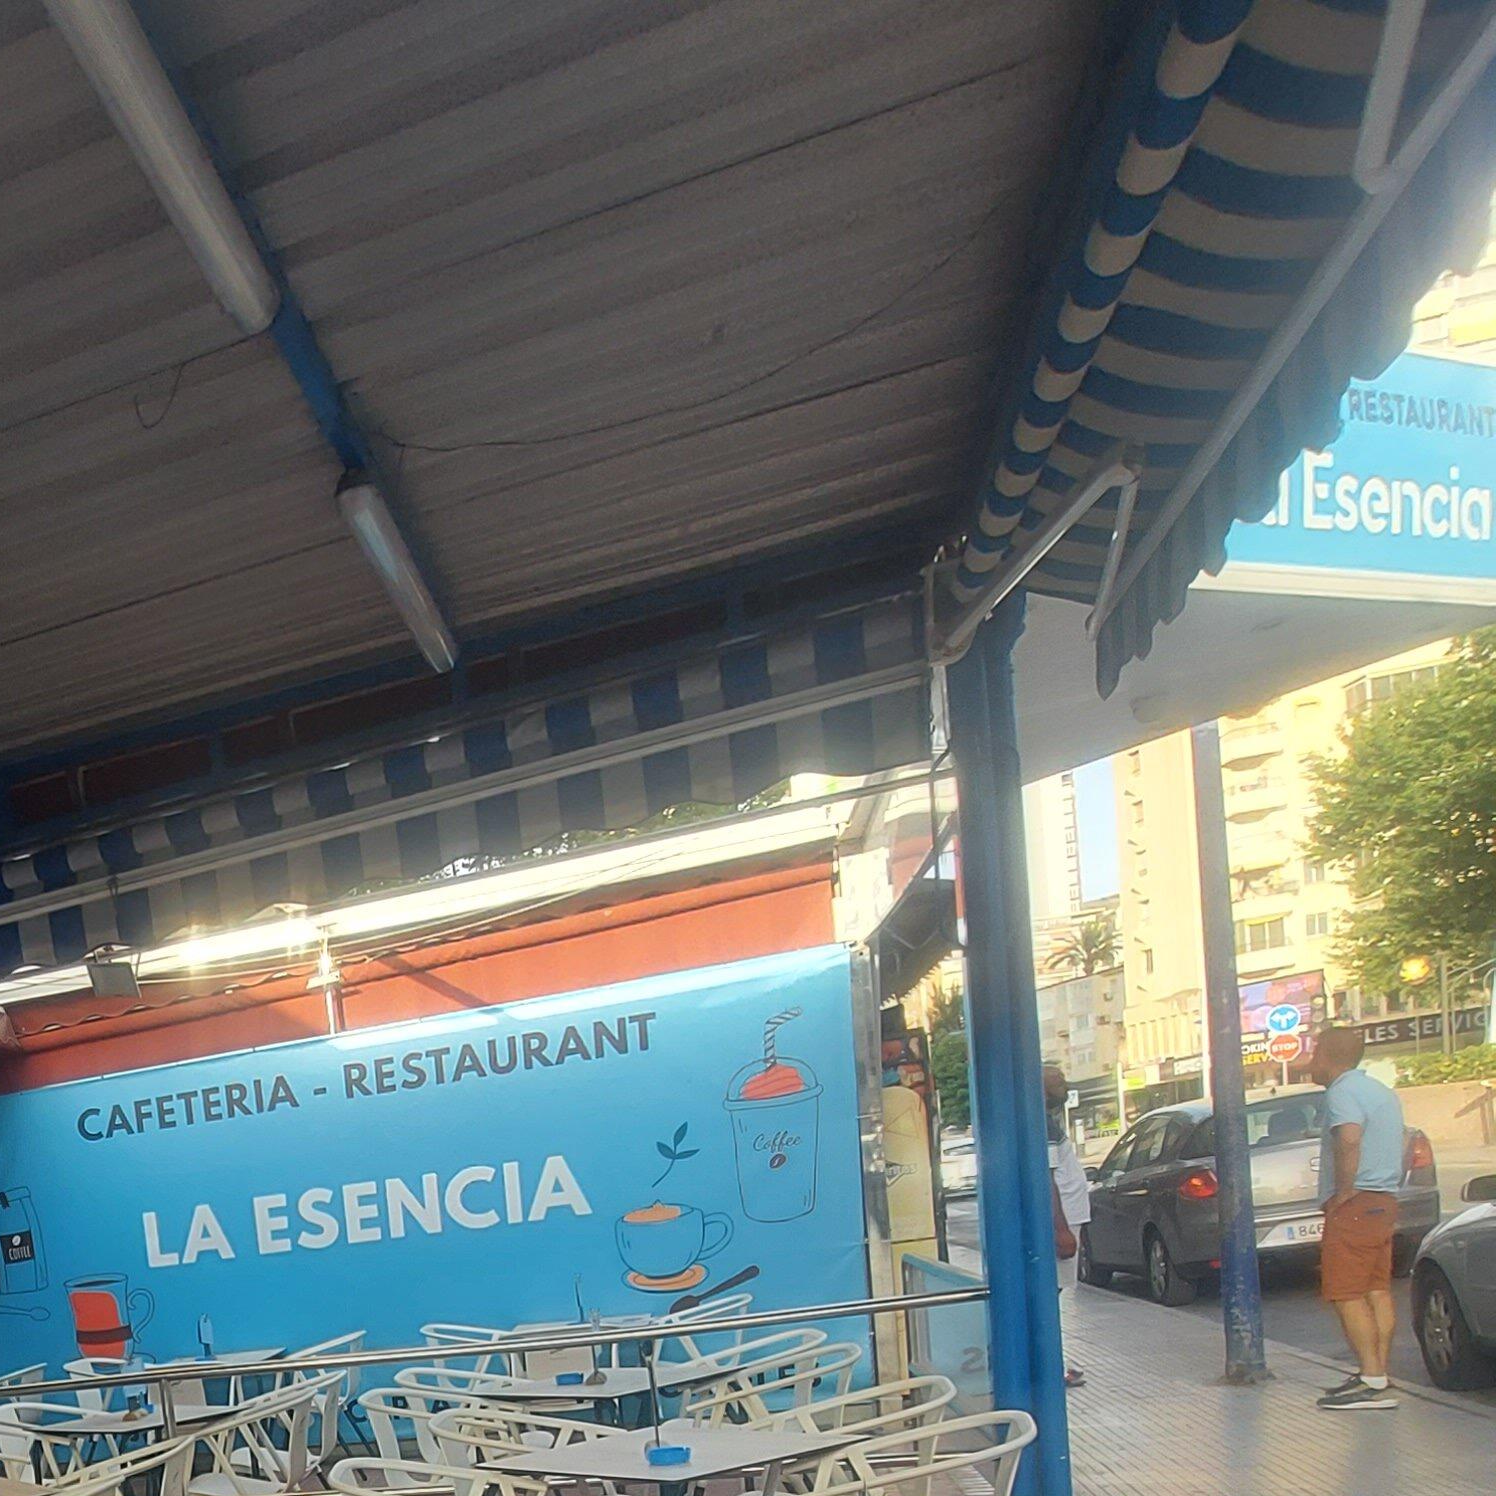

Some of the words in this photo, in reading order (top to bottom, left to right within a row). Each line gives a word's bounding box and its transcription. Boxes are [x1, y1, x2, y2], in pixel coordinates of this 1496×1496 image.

[1347, 387, 1496, 438] RESTAURANT
[1303, 449, 1491, 541] Esencia
[77, 1075, 300, 1141] CAFETERIA
[343, 1012, 657, 1099] RESTAURANT
[1272, 1041, 1298, 1053] STOP
[753, 1130, 801, 1153] Coffee
[142, 1203, 236, 1268] LA
[253, 1155, 593, 1255] ESENCIA
